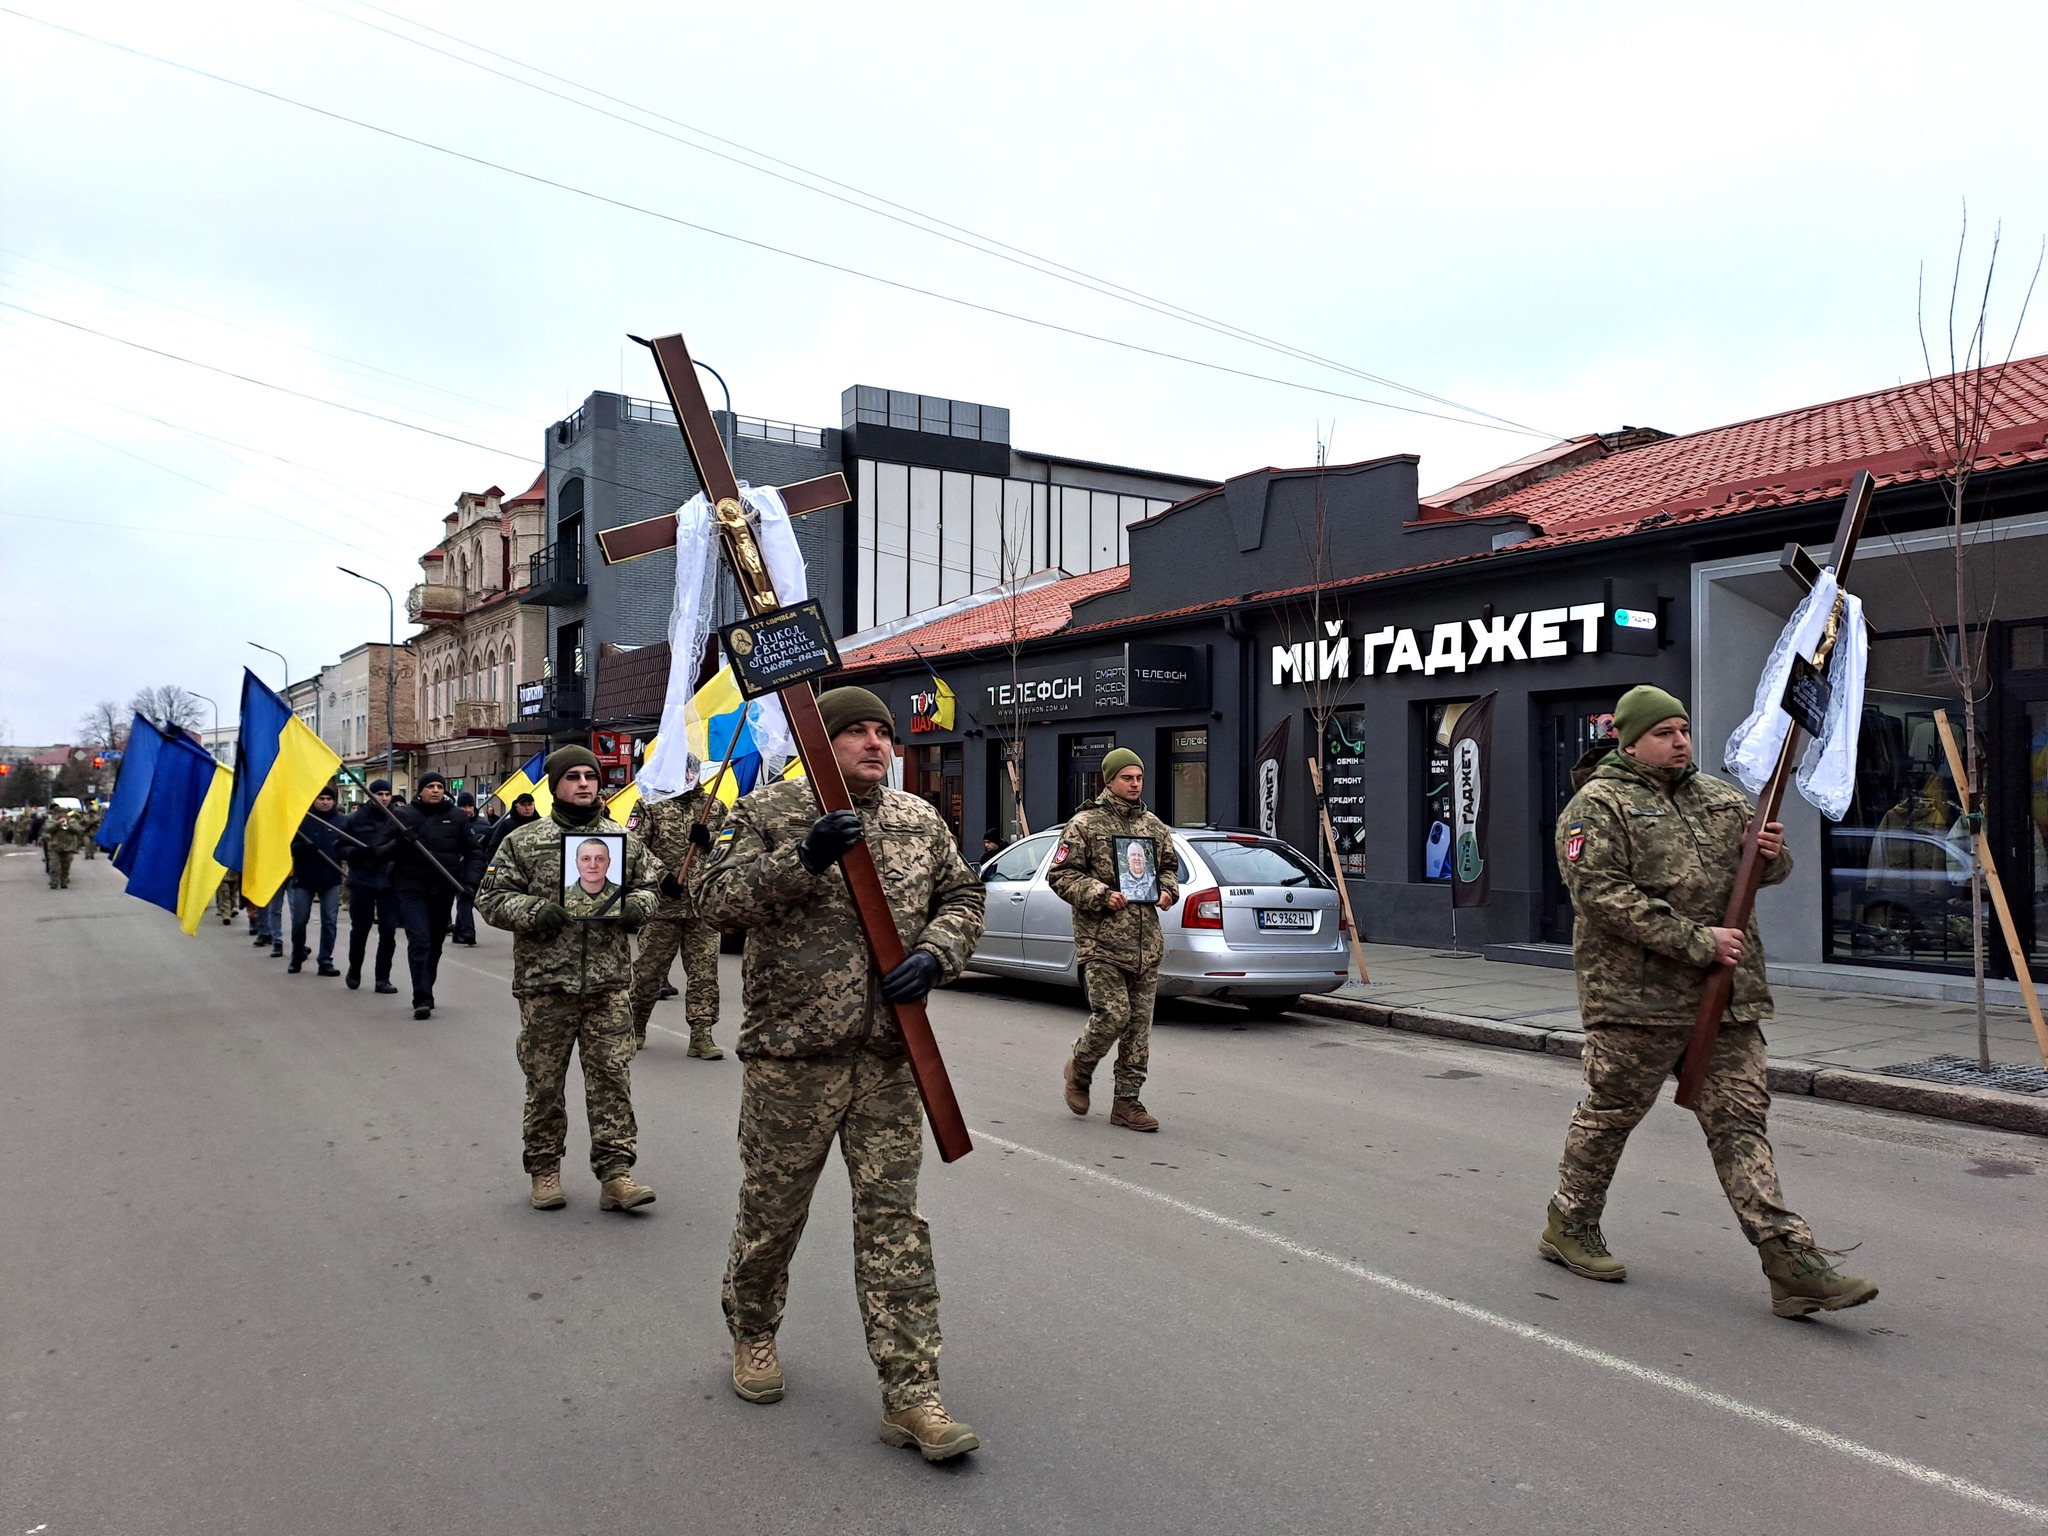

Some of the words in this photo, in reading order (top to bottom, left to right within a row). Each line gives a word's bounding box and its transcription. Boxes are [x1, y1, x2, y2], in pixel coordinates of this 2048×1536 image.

[1272, 619, 1349, 685] МІЙ
[1364, 602, 1605, 676] ҐАДЖЕТ
[1135, 669, 1187, 680] ТЕЛЕФОН
[987, 676, 1082, 706] ТЕЛЕФОН
[1333, 777, 1362, 785] РЕМОНТ
[1462, 747, 1474, 825] ҐАДЖЕТ
[1329, 796, 1358, 804] КРЕДИТ
[1266, 912, 1278, 924] AC
[1279, 913, 1298, 924] 9362
[1299, 913, 1310, 925] HI
